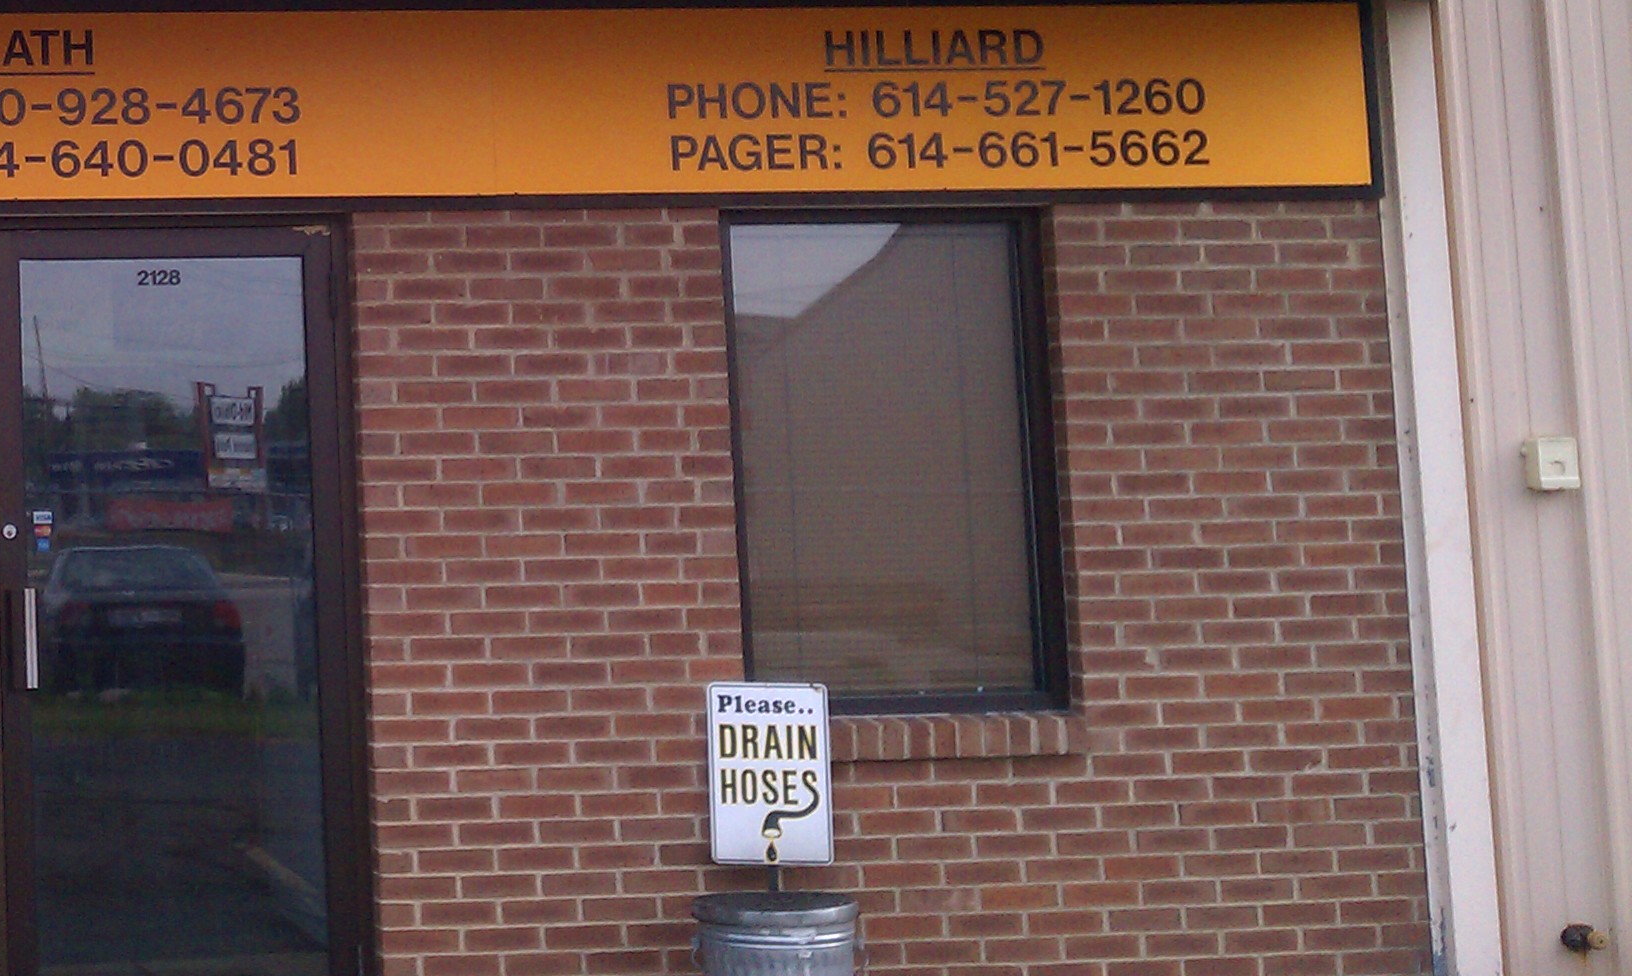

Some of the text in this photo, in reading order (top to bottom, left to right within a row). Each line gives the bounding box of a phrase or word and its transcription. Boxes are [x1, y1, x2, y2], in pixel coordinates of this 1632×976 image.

[824, 29, 1044, 67] HILLIARD
[666, 77, 1207, 120] PHONE: 614-527-1260
[669, 129, 1211, 173] PAGER: 614-661-5662
[137, 269, 182, 287] 2128
[718, 722, 819, 761] DRAIN
[719, 767, 820, 807] HOSES
